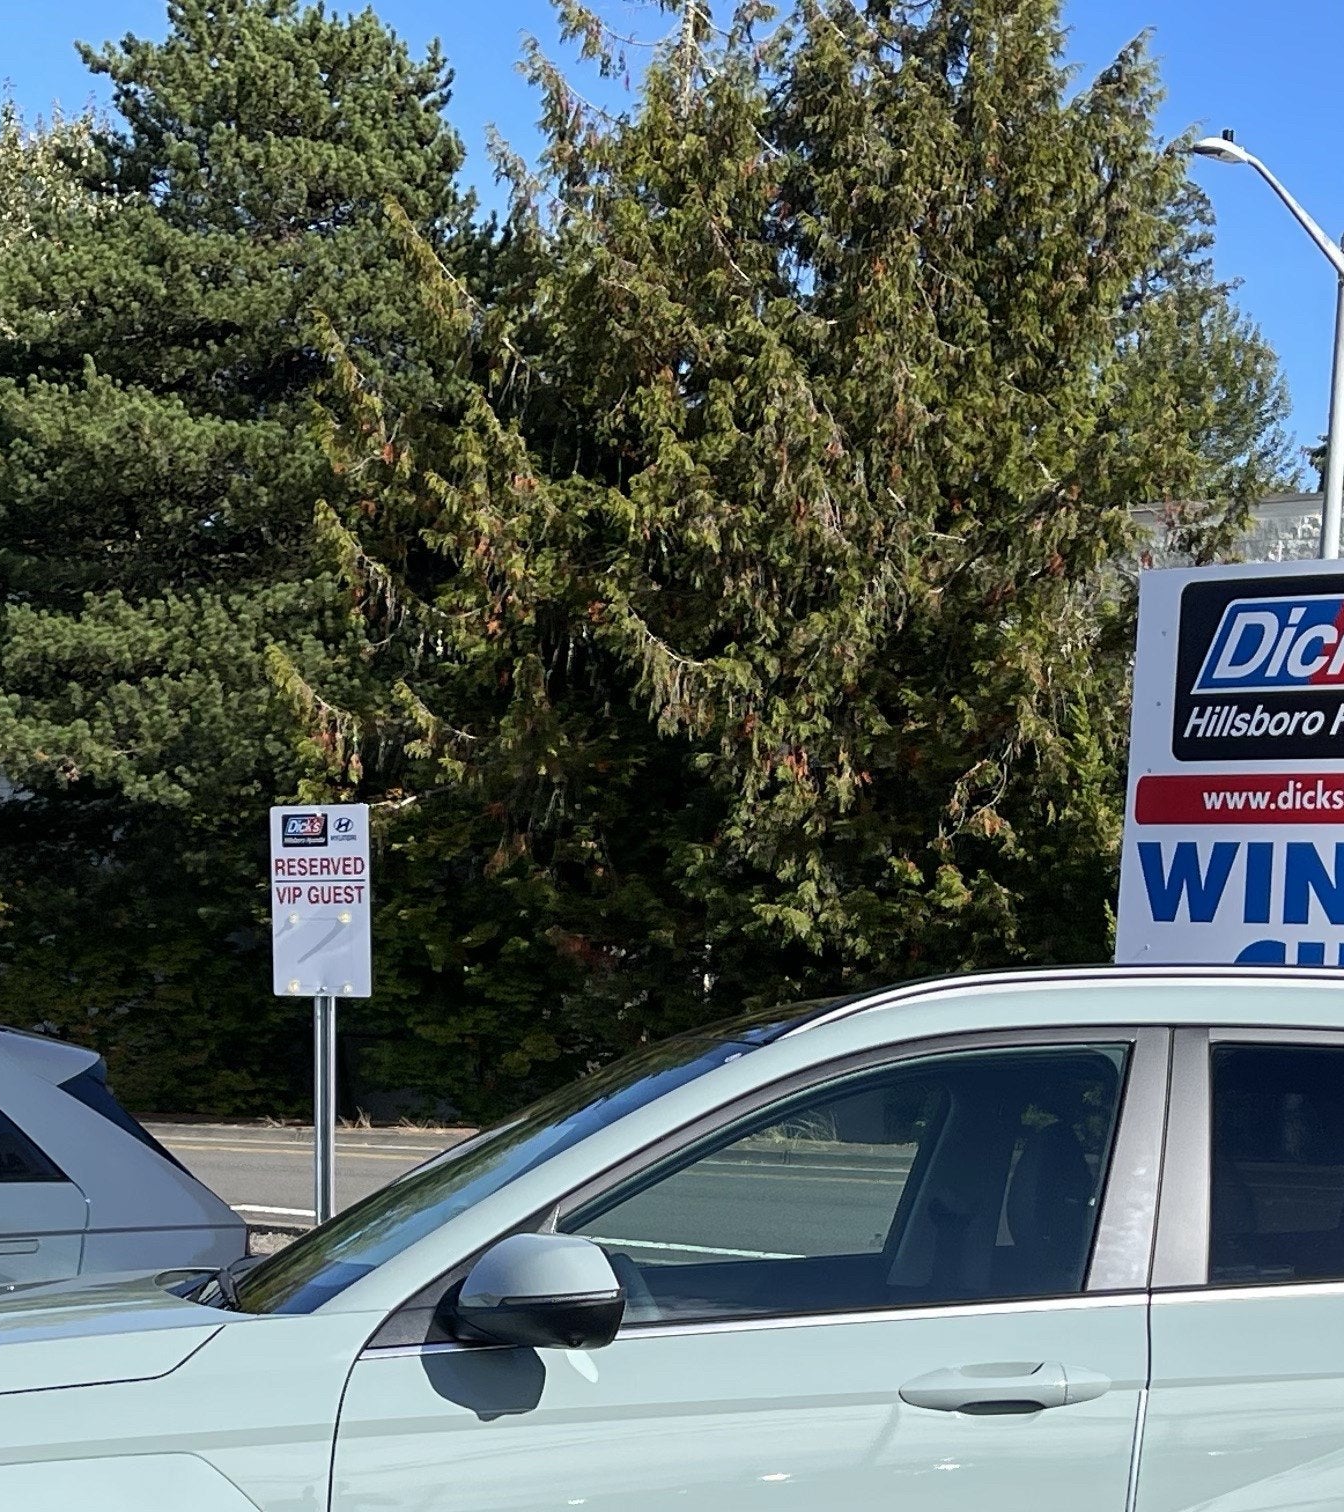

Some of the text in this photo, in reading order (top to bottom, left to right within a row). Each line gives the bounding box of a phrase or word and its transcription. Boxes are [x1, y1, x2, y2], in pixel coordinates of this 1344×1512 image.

[1182, 704, 1326, 739] Hillsboro
[274, 856, 365, 876] RESERVED
[276, 885, 365, 905] VIP GUEST
